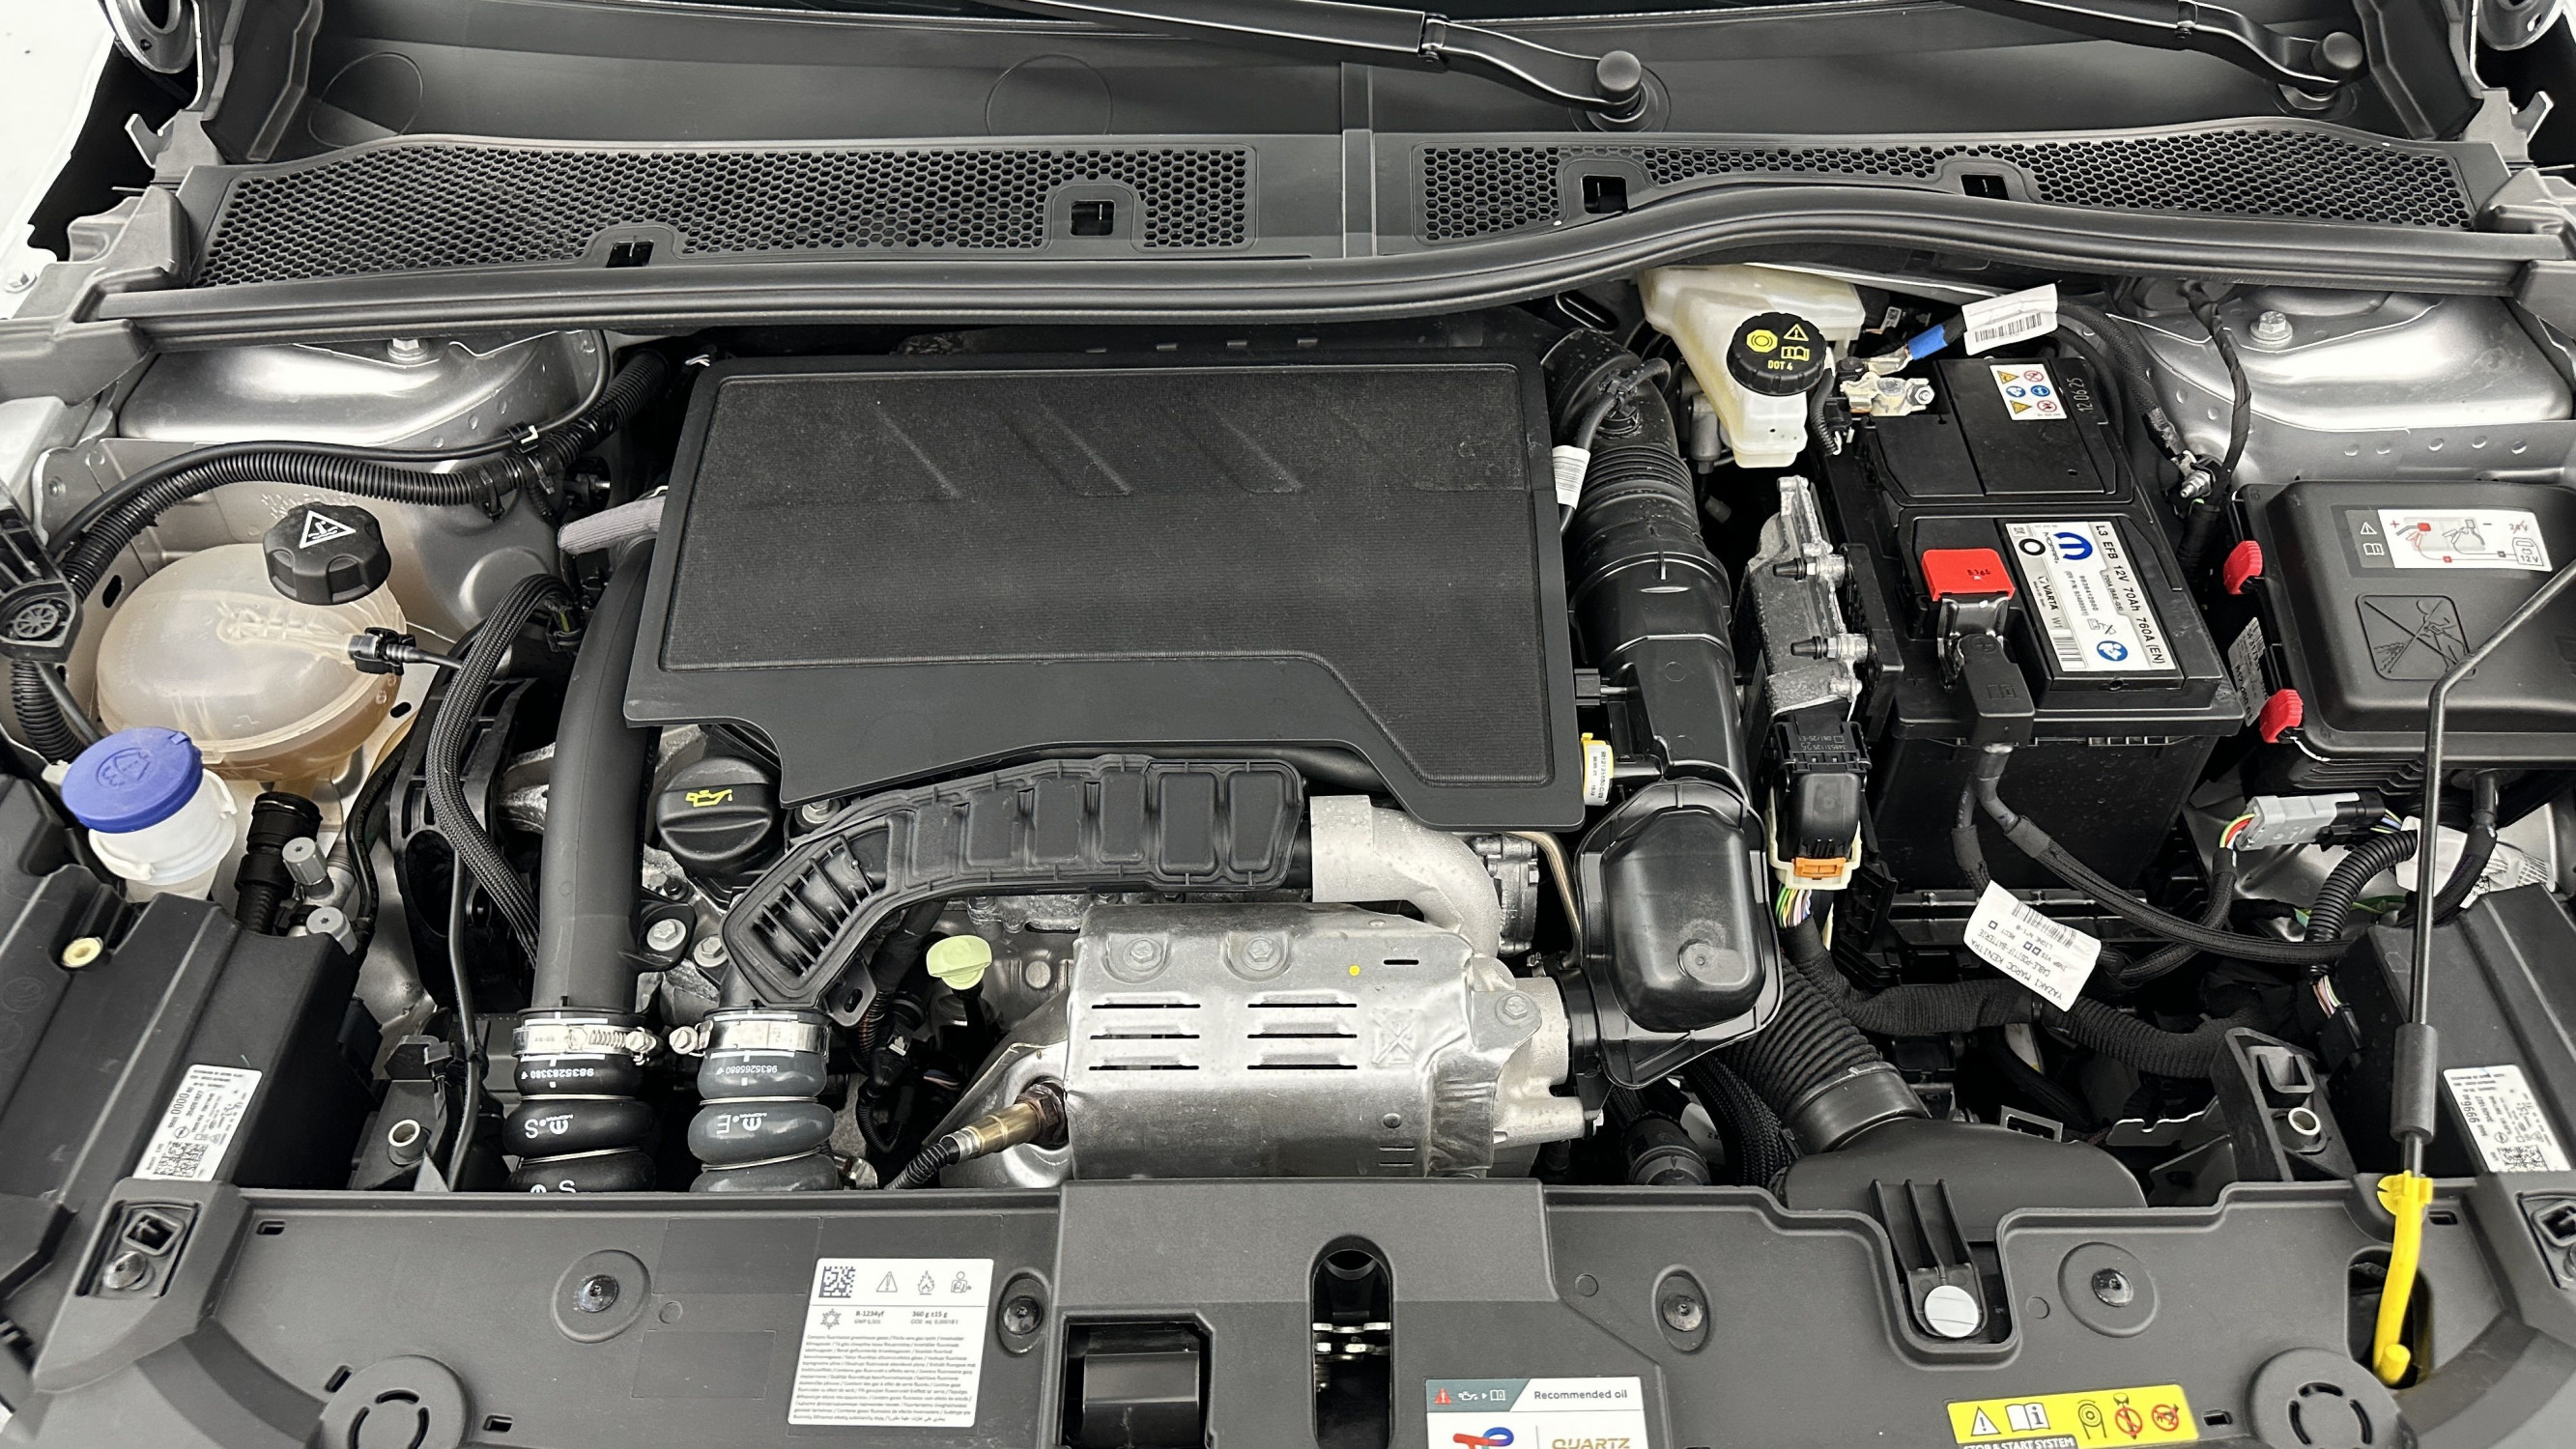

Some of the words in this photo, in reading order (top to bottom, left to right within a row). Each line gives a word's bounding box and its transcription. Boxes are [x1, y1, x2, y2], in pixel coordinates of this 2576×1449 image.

[1767, 359, 1786, 370] DOT
[1786, 361, 1793, 371] 4
[2096, 525, 2109, 536] L3
[2102, 541, 2119, 559] EFB
[2520, 554, 2532, 563] 12
[2113, 564, 2131, 582] 12V
[2041, 583, 2059, 611] VARTA
[2122, 586, 2141, 611] 70Ah
[2136, 617, 2156, 642] 760A
[2146, 644, 2166, 666] (EN)
[1971, 938, 2005, 965] KENITRA
[1977, 928, 2051, 978] CABLE-POSITIF-BATTERIE
[2005, 961, 2033, 981] MAROC
[2034, 978, 2063, 1001] YAZAKI
[1533, 1389, 1612, 1401] Recommended
[1615, 1389, 1628, 1400] oil
[1552, 1437, 1631, 1449] QUARTZ
[2002, 1441, 2034, 1449] START
[2034, 1437, 2075, 1449] SYSTEM
